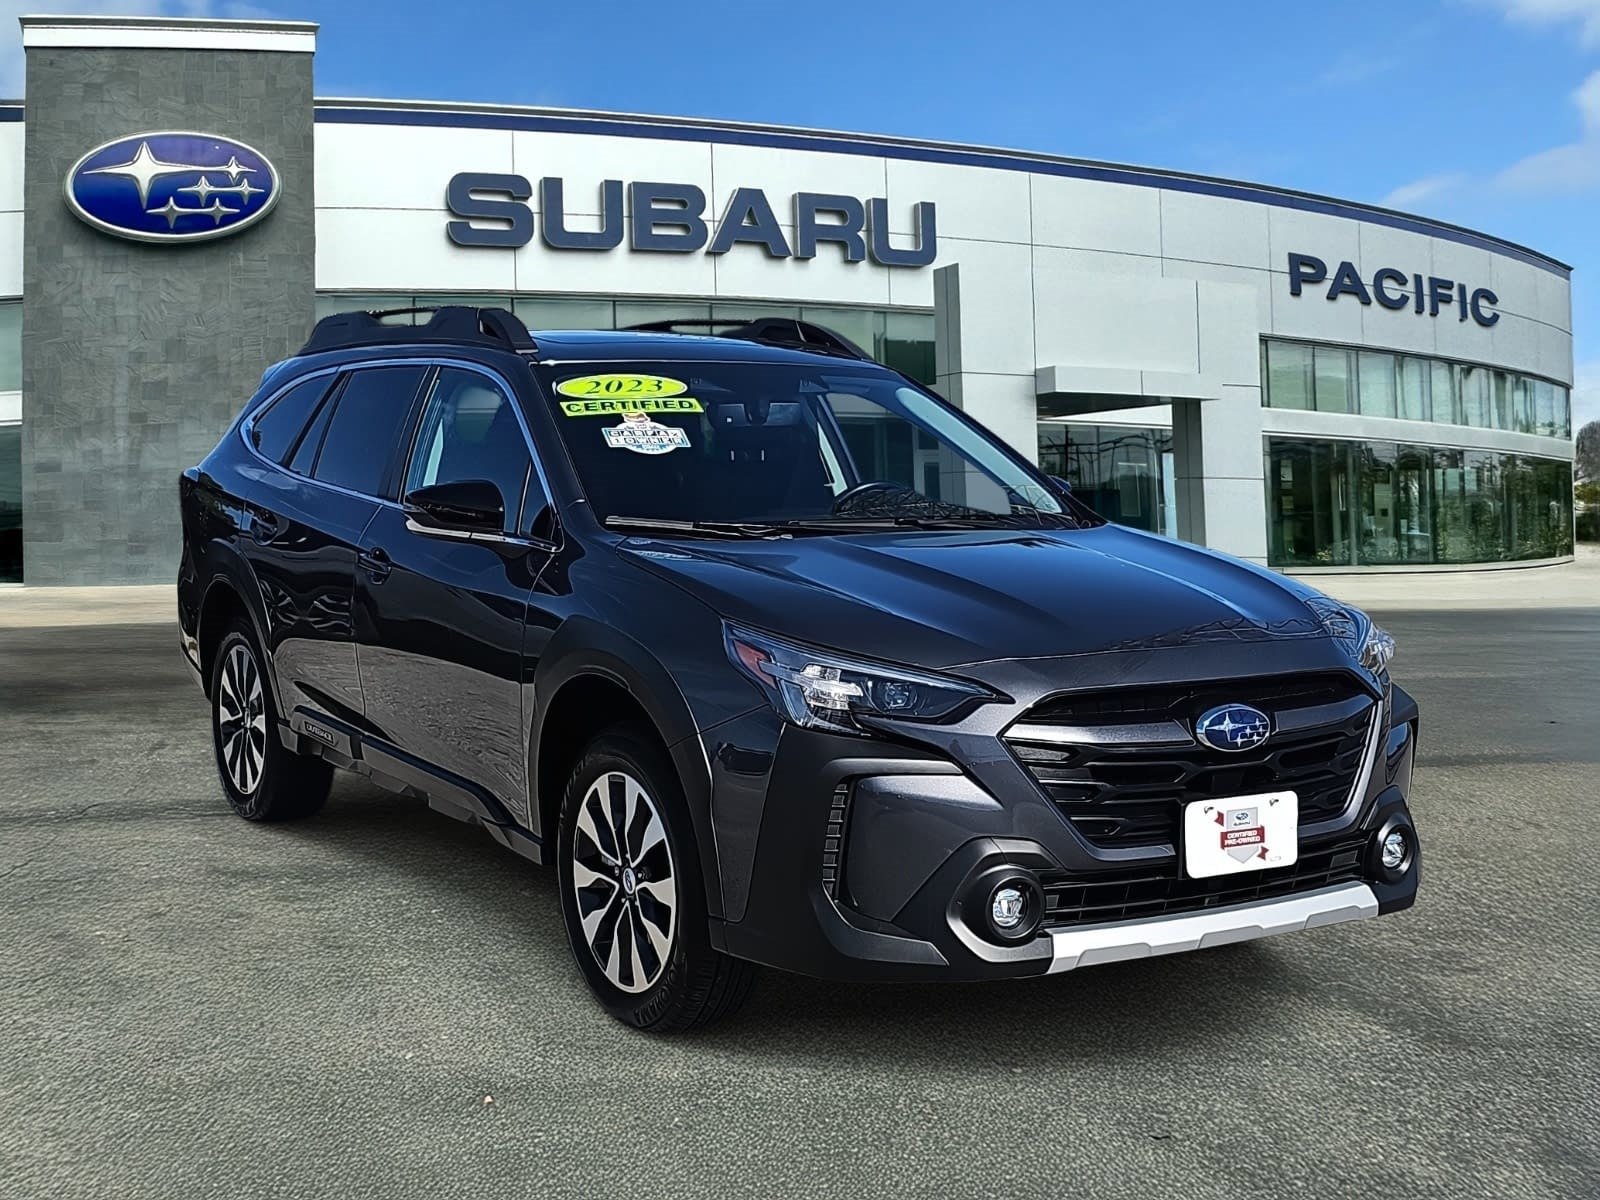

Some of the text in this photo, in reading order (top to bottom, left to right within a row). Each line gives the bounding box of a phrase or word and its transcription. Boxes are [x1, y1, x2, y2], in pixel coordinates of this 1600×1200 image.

[447, 171, 936, 268] SUBARU
[1288, 252, 1500, 327] PACIFIC
[584, 379, 663, 395] 2023
[565, 400, 694, 413] CERTIFIED
[1224, 836, 1261, 846] PRE-OWNED
[1227, 830, 1258, 839] CERTIFIED
